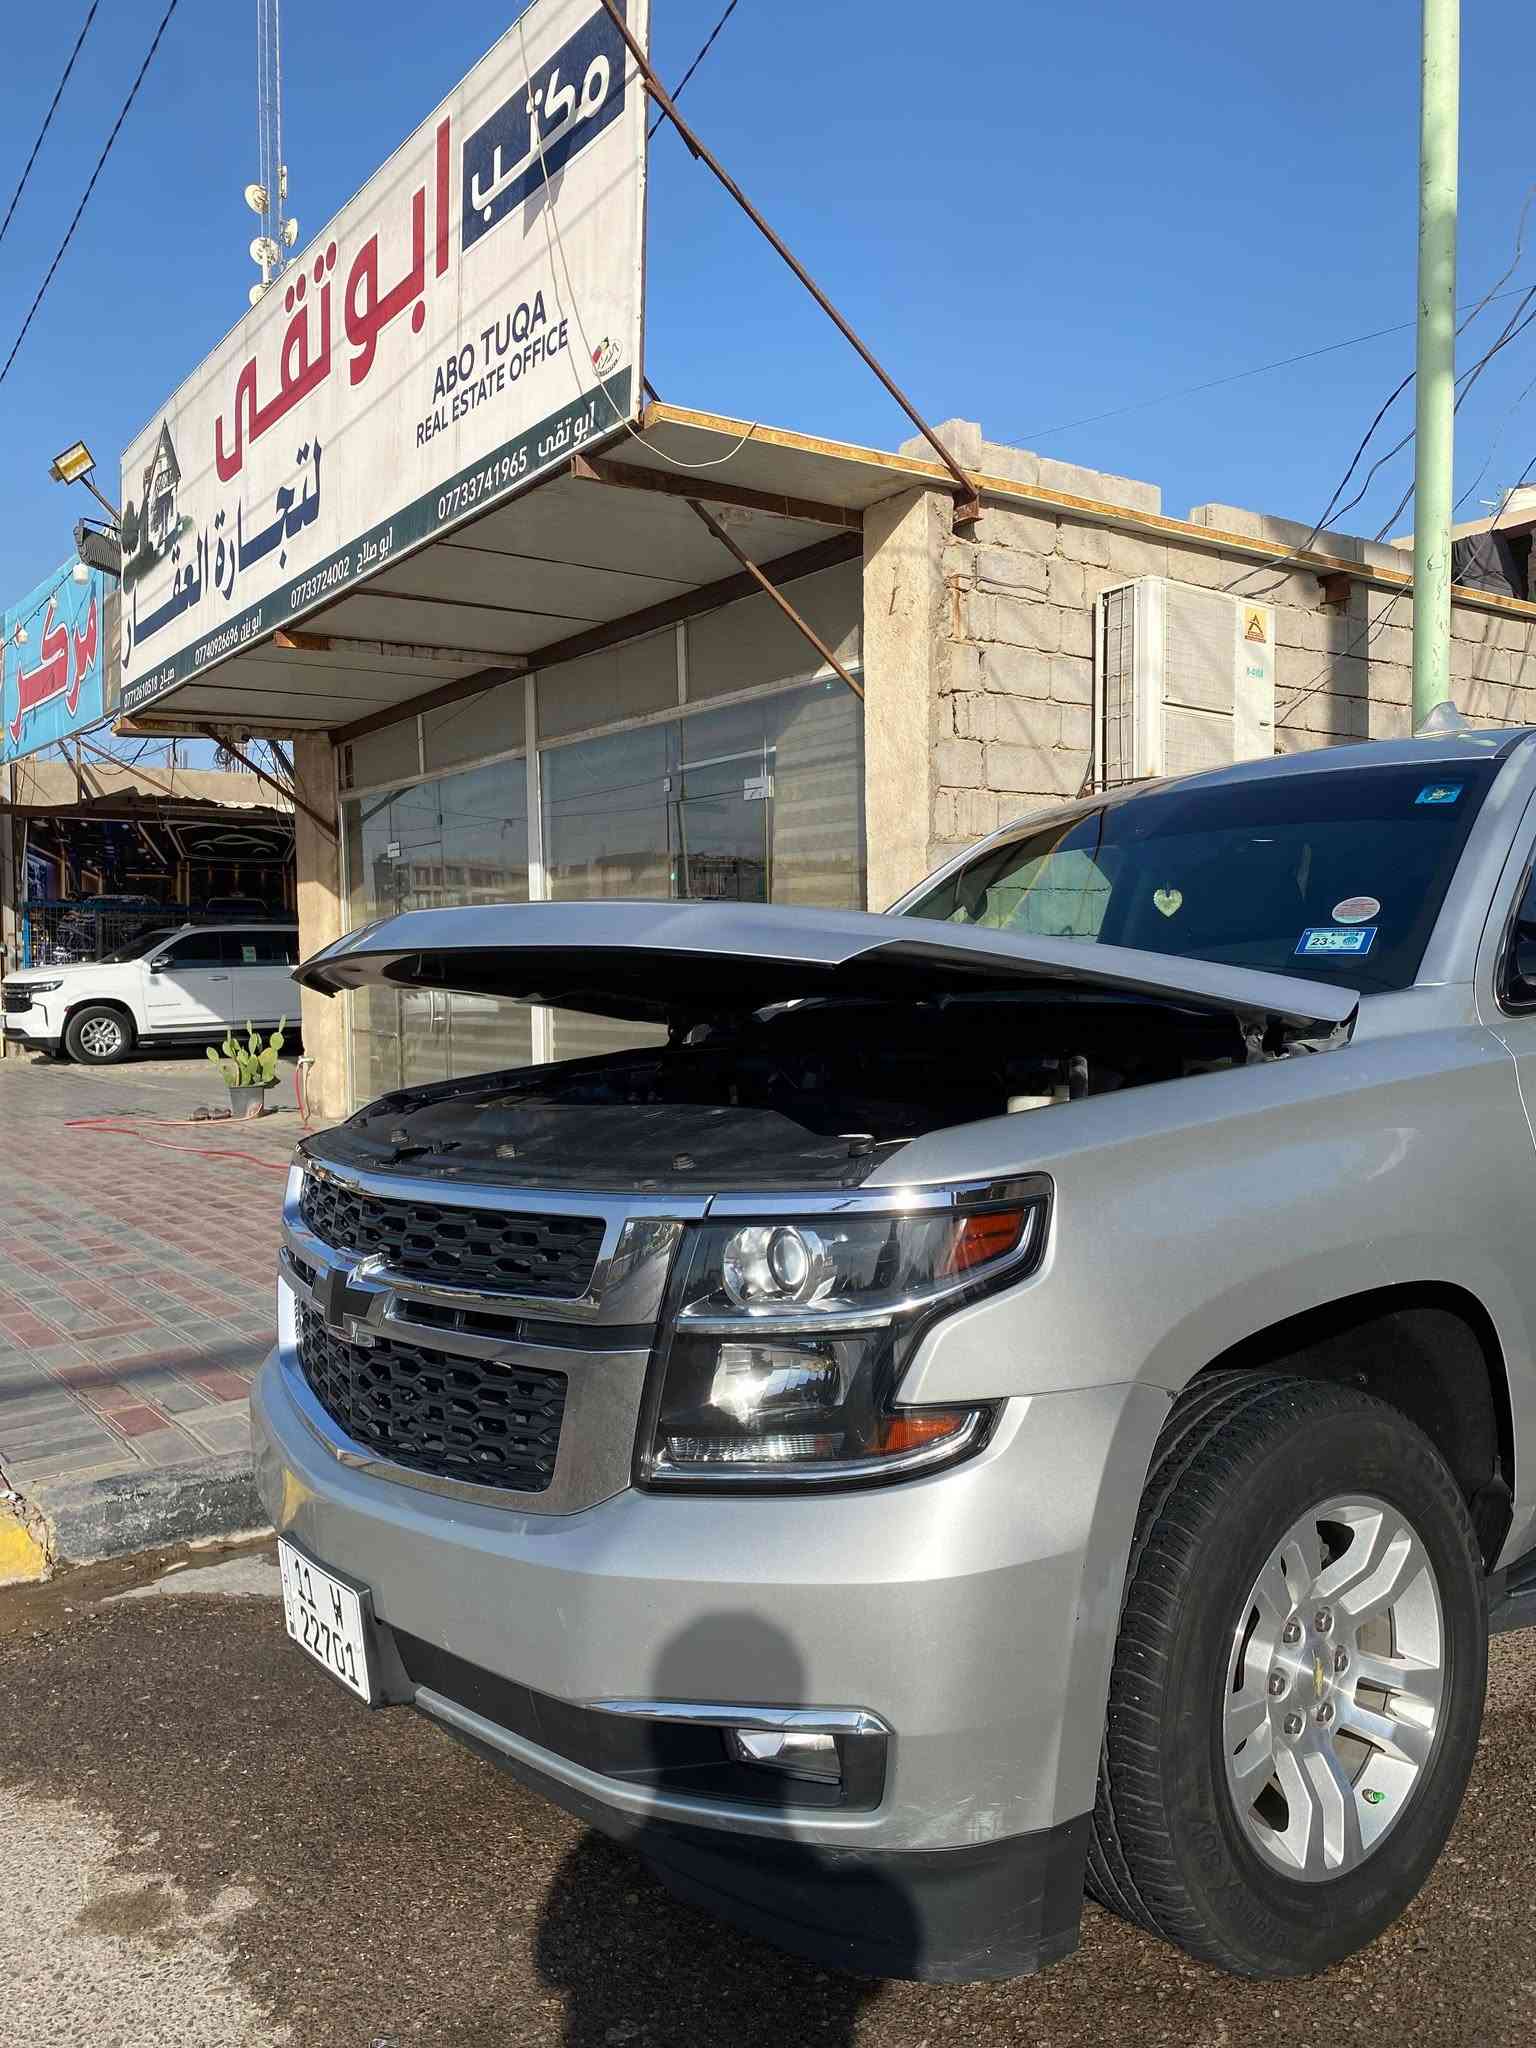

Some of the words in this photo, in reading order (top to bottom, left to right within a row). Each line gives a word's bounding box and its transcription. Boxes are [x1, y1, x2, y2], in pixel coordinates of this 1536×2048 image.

[471, 54, 610, 222] مكتب
[416, 409, 449, 448] REAL
[452, 364, 505, 423] ESTATE
[509, 318, 568, 381] OFFICE
[432, 343, 475, 405] ABO
[481, 290, 547, 365] TUQA
[438, 446, 527, 520] 07733741965
[291, 556, 350, 609] 07733724002
[194, 625, 238, 665] 07740926696
[294, 1559, 316, 1610] 11
[300, 1605, 359, 1688] 22701
